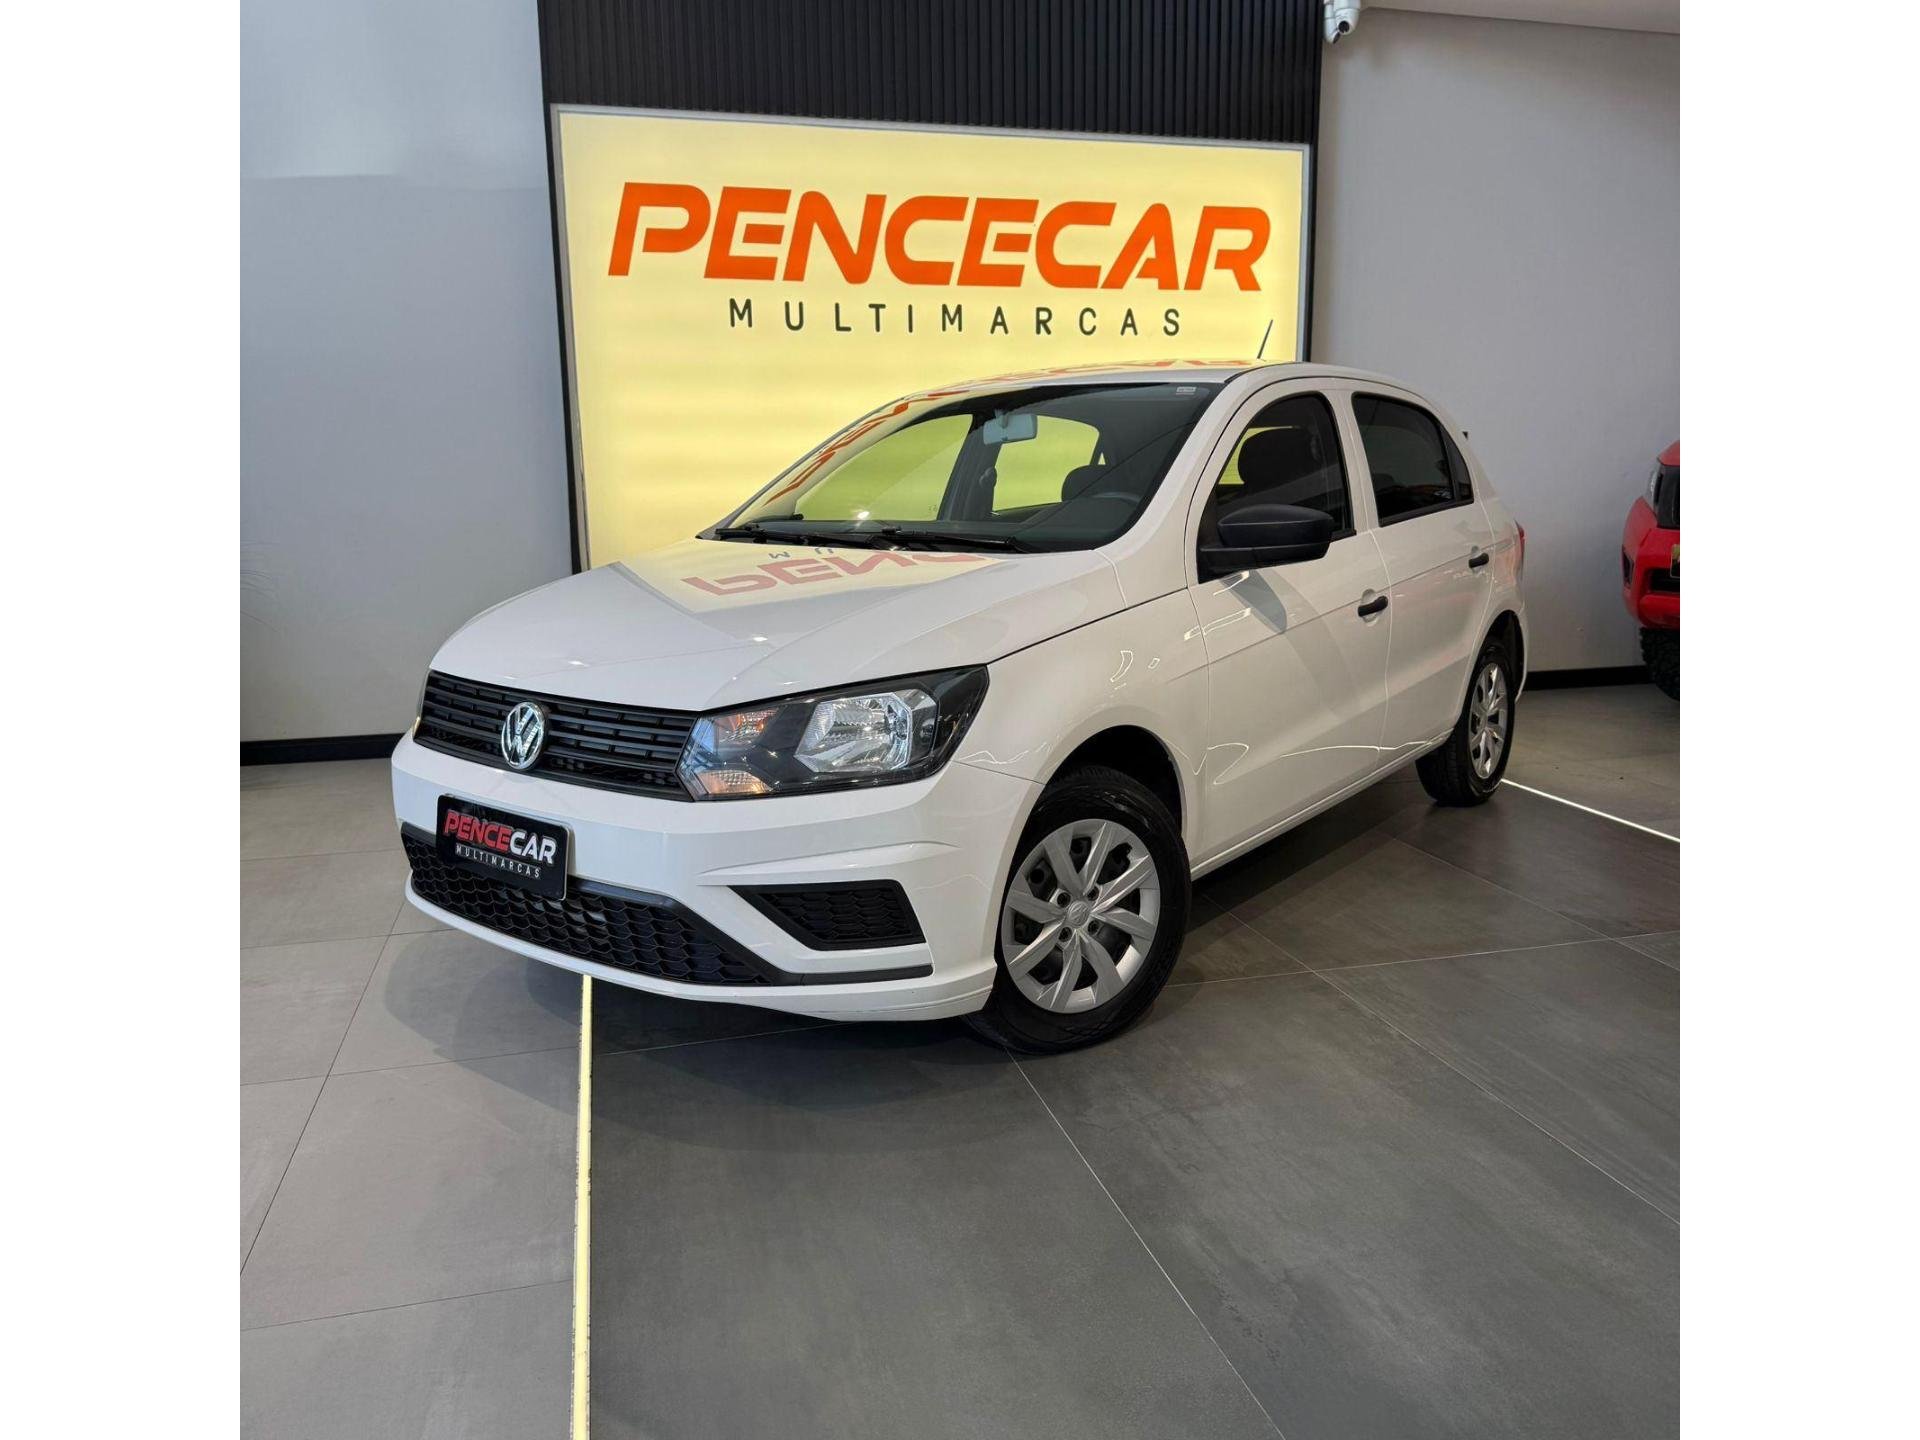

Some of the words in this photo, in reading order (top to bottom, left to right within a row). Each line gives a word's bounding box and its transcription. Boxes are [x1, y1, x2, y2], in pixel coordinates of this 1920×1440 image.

[609, 182, 1271, 291] PENCECAR
[729, 298, 1181, 336] MULTIMARCAS
[444, 809, 557, 864] PENCECAR
[455, 844, 540, 878] MULTIMARCAS
